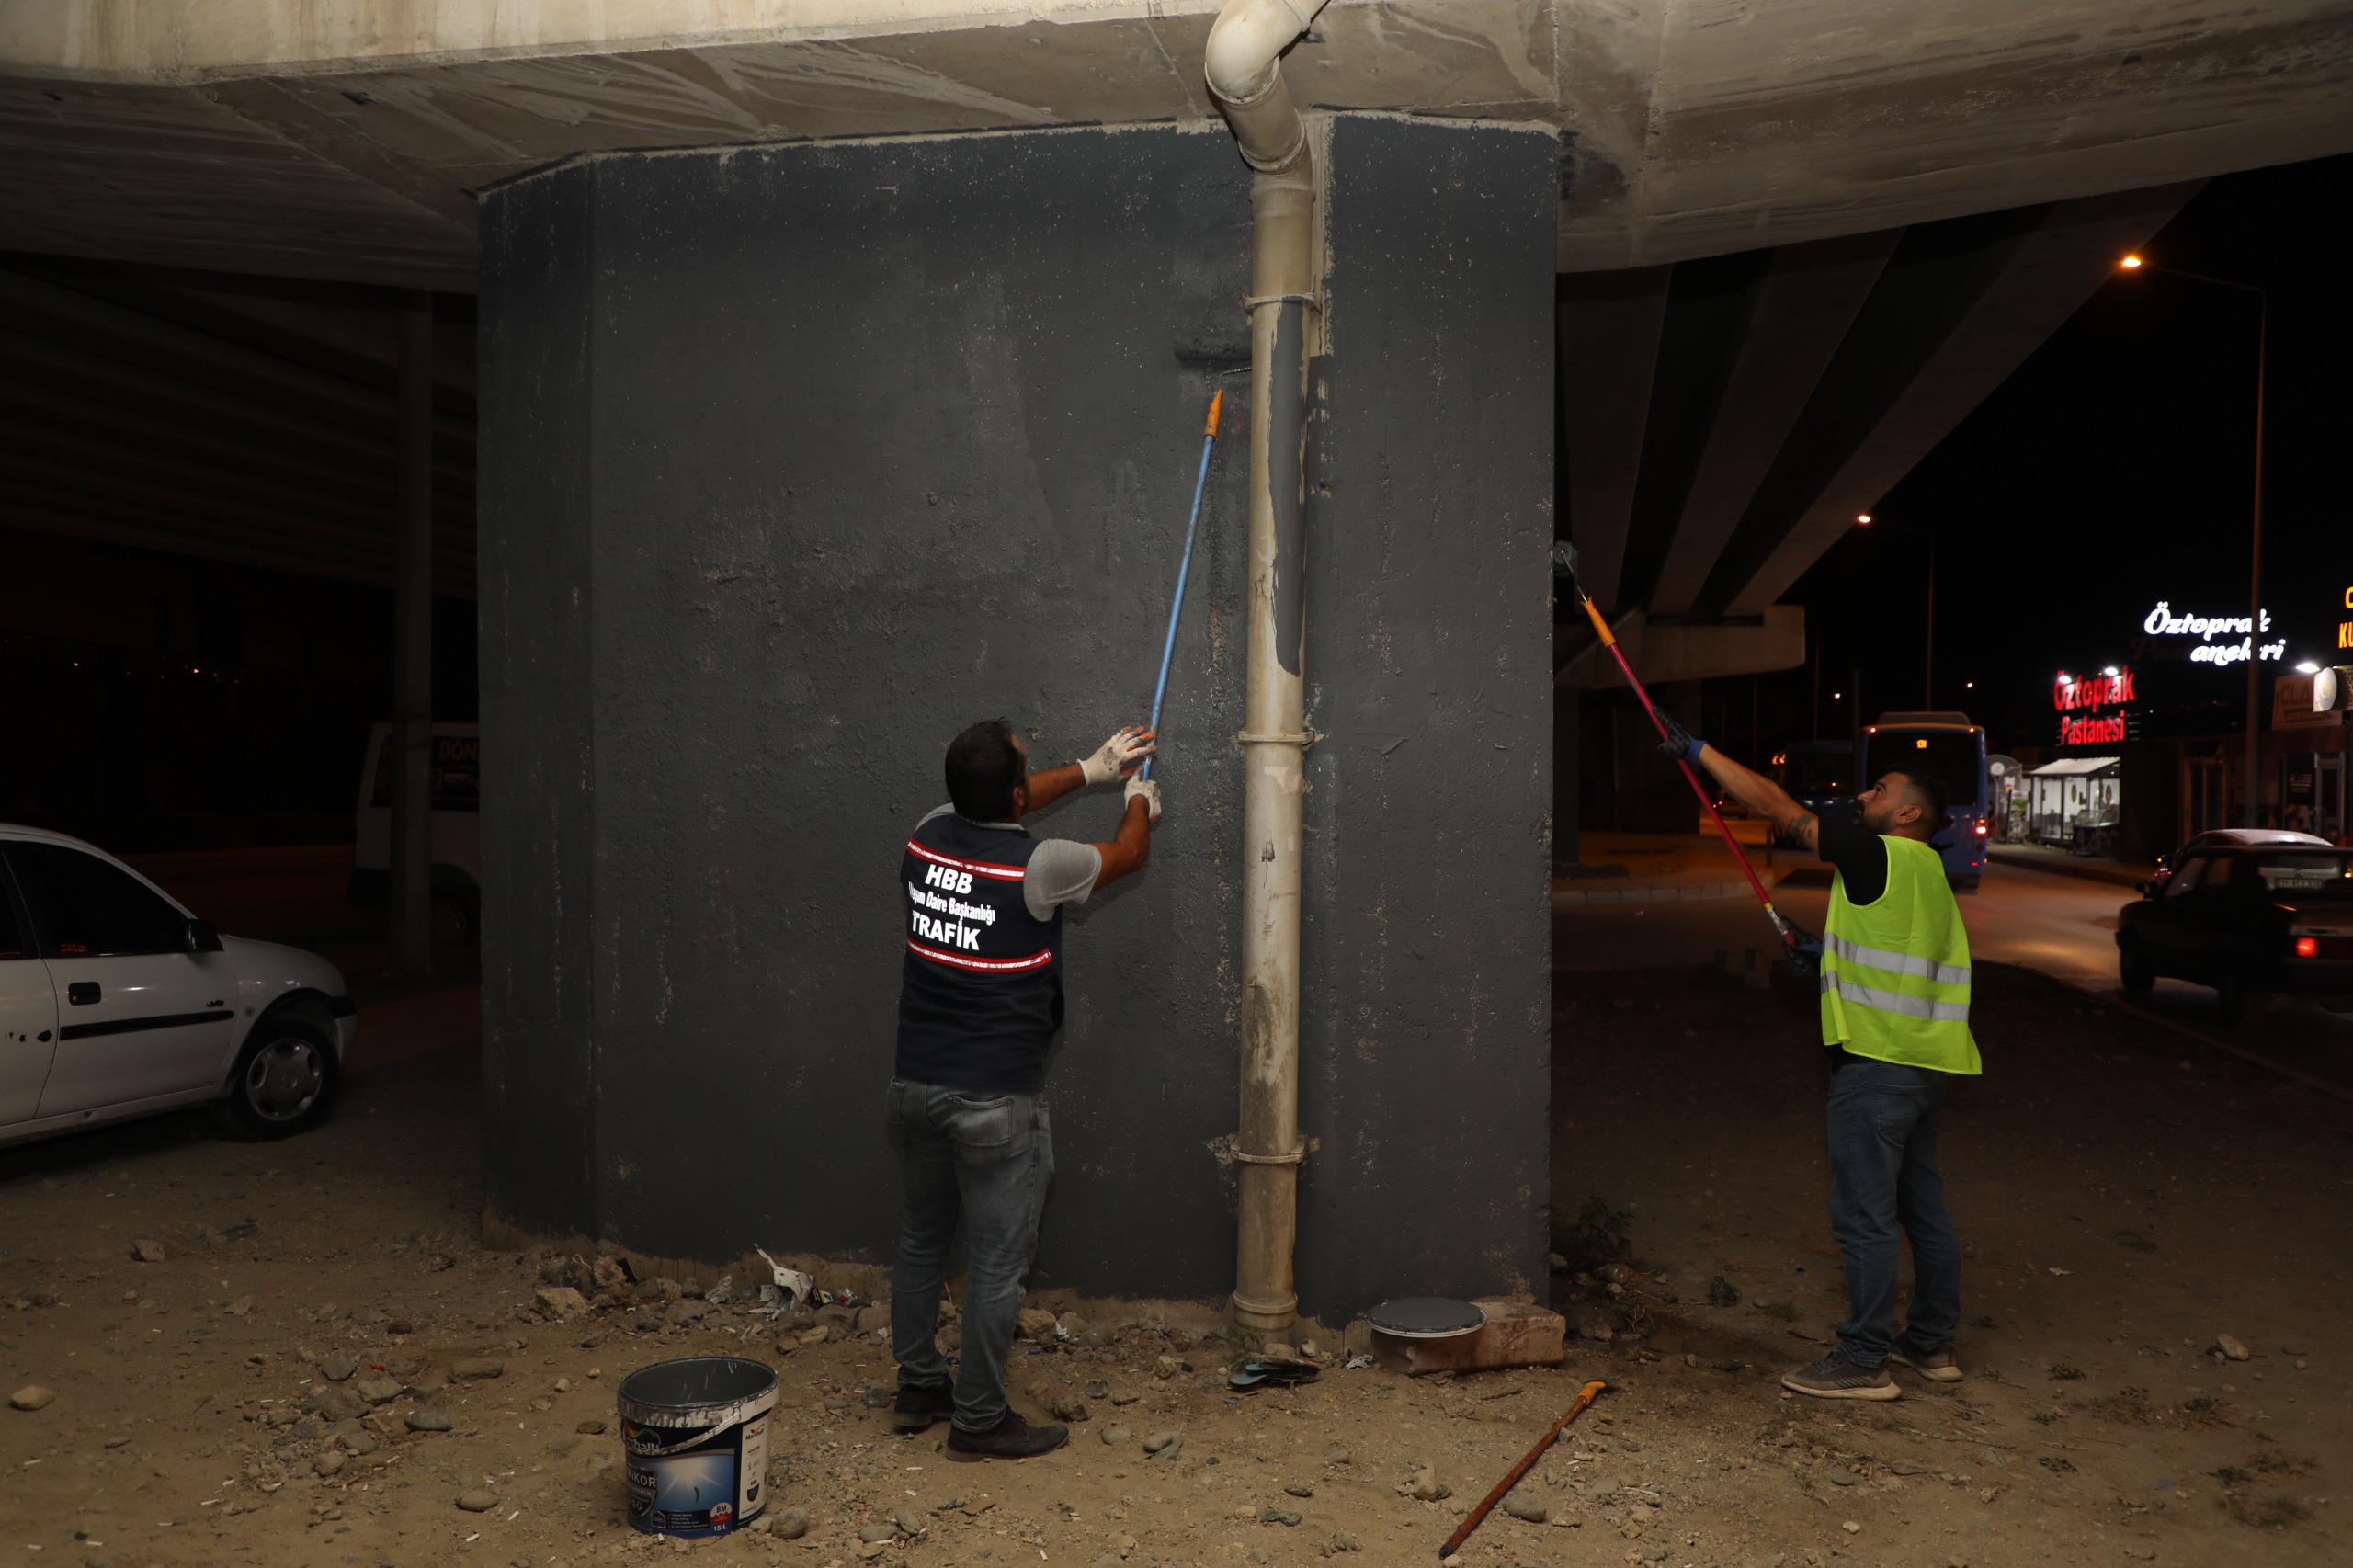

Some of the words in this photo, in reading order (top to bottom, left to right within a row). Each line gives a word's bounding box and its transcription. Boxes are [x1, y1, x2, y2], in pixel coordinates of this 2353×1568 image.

[2144, 601, 2271, 641] Öztoprak
[2053, 665, 2135, 713] Öztoprak
[2061, 710, 2126, 745] Pastanesi
[438, 736, 480, 762] DÖN
[925, 864, 973, 894] HBB
[926, 890, 948, 913] Daire
[949, 897, 996, 926] Başkanlığı
[912, 910, 982, 951] TRAFİK
